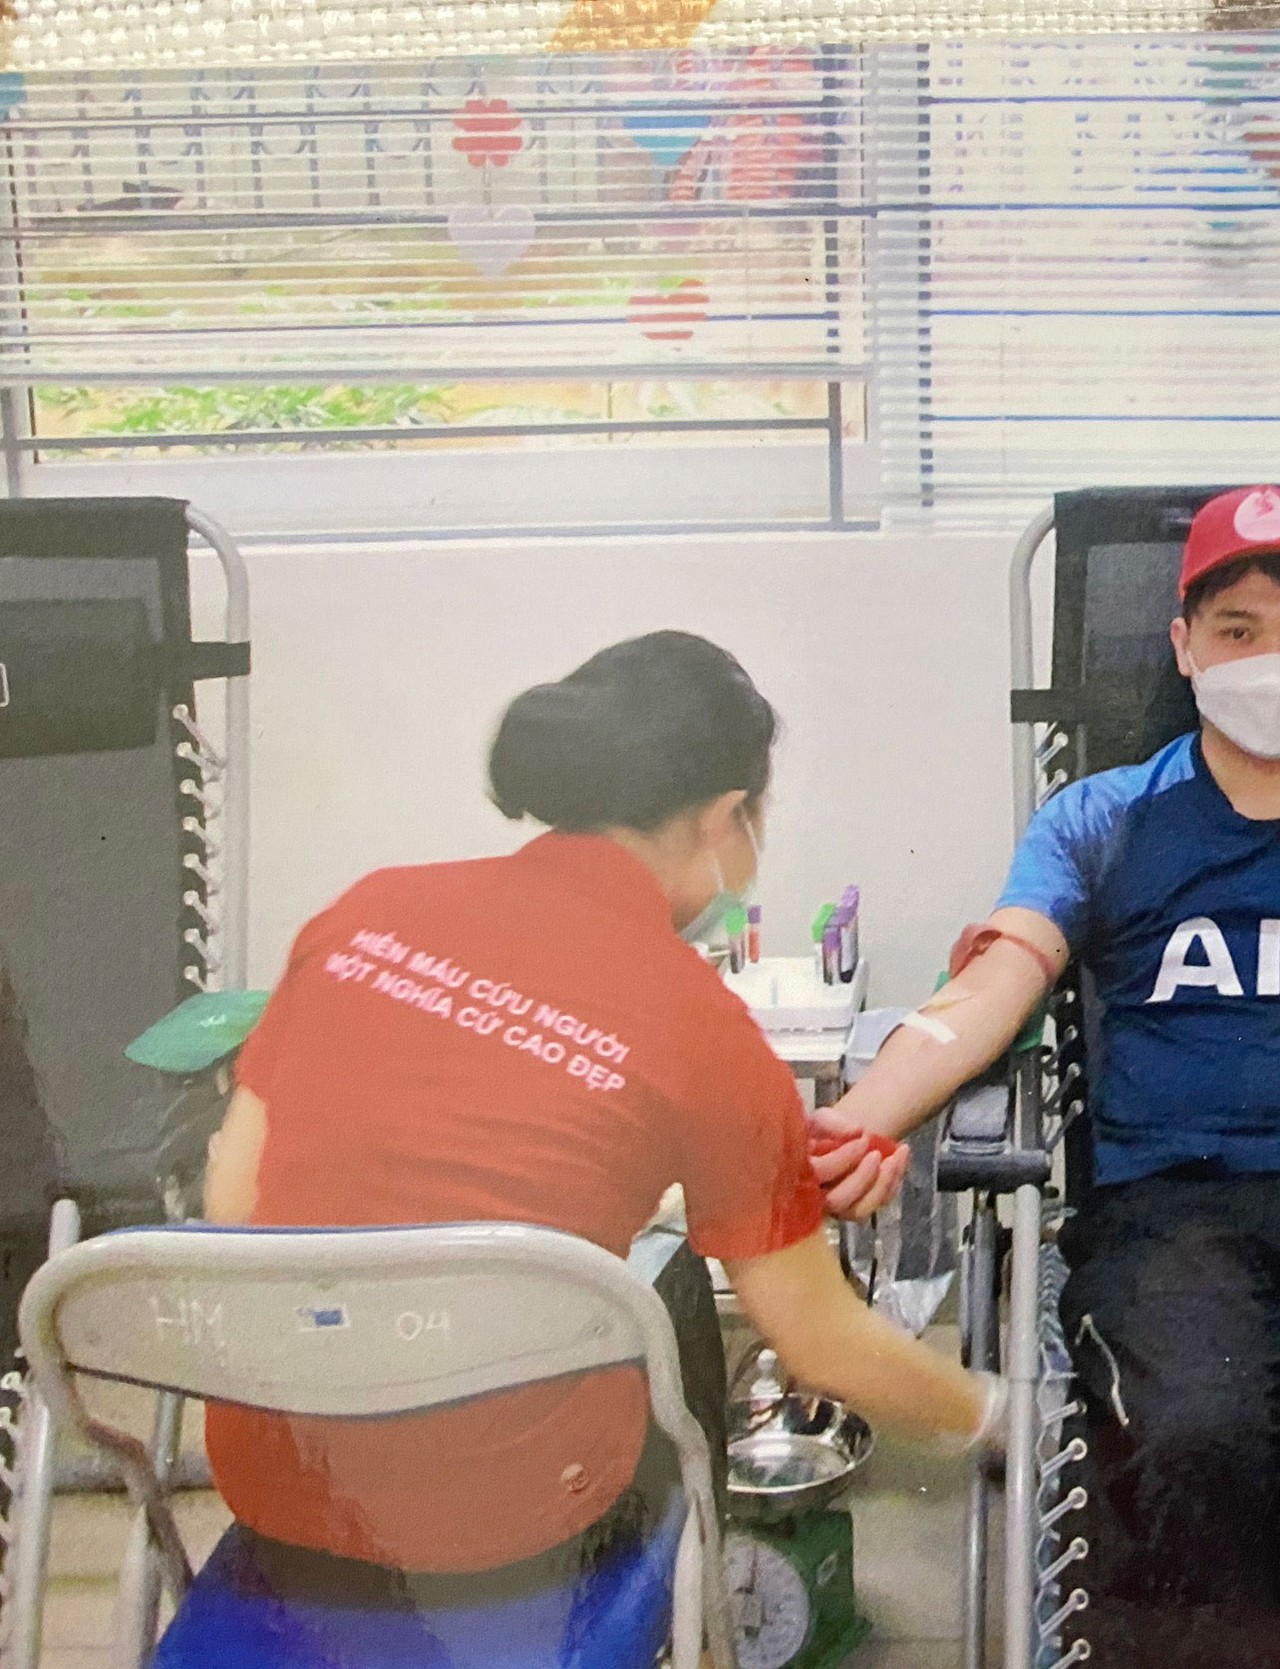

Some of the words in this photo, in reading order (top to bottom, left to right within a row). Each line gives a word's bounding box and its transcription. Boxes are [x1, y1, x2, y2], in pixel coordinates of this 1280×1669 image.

[406, 952, 471, 987] MÁU
[468, 978, 534, 1015] CỨU
[502, 1025, 566, 1064] CAO
[566, 1054, 627, 1091] ĐẸP
